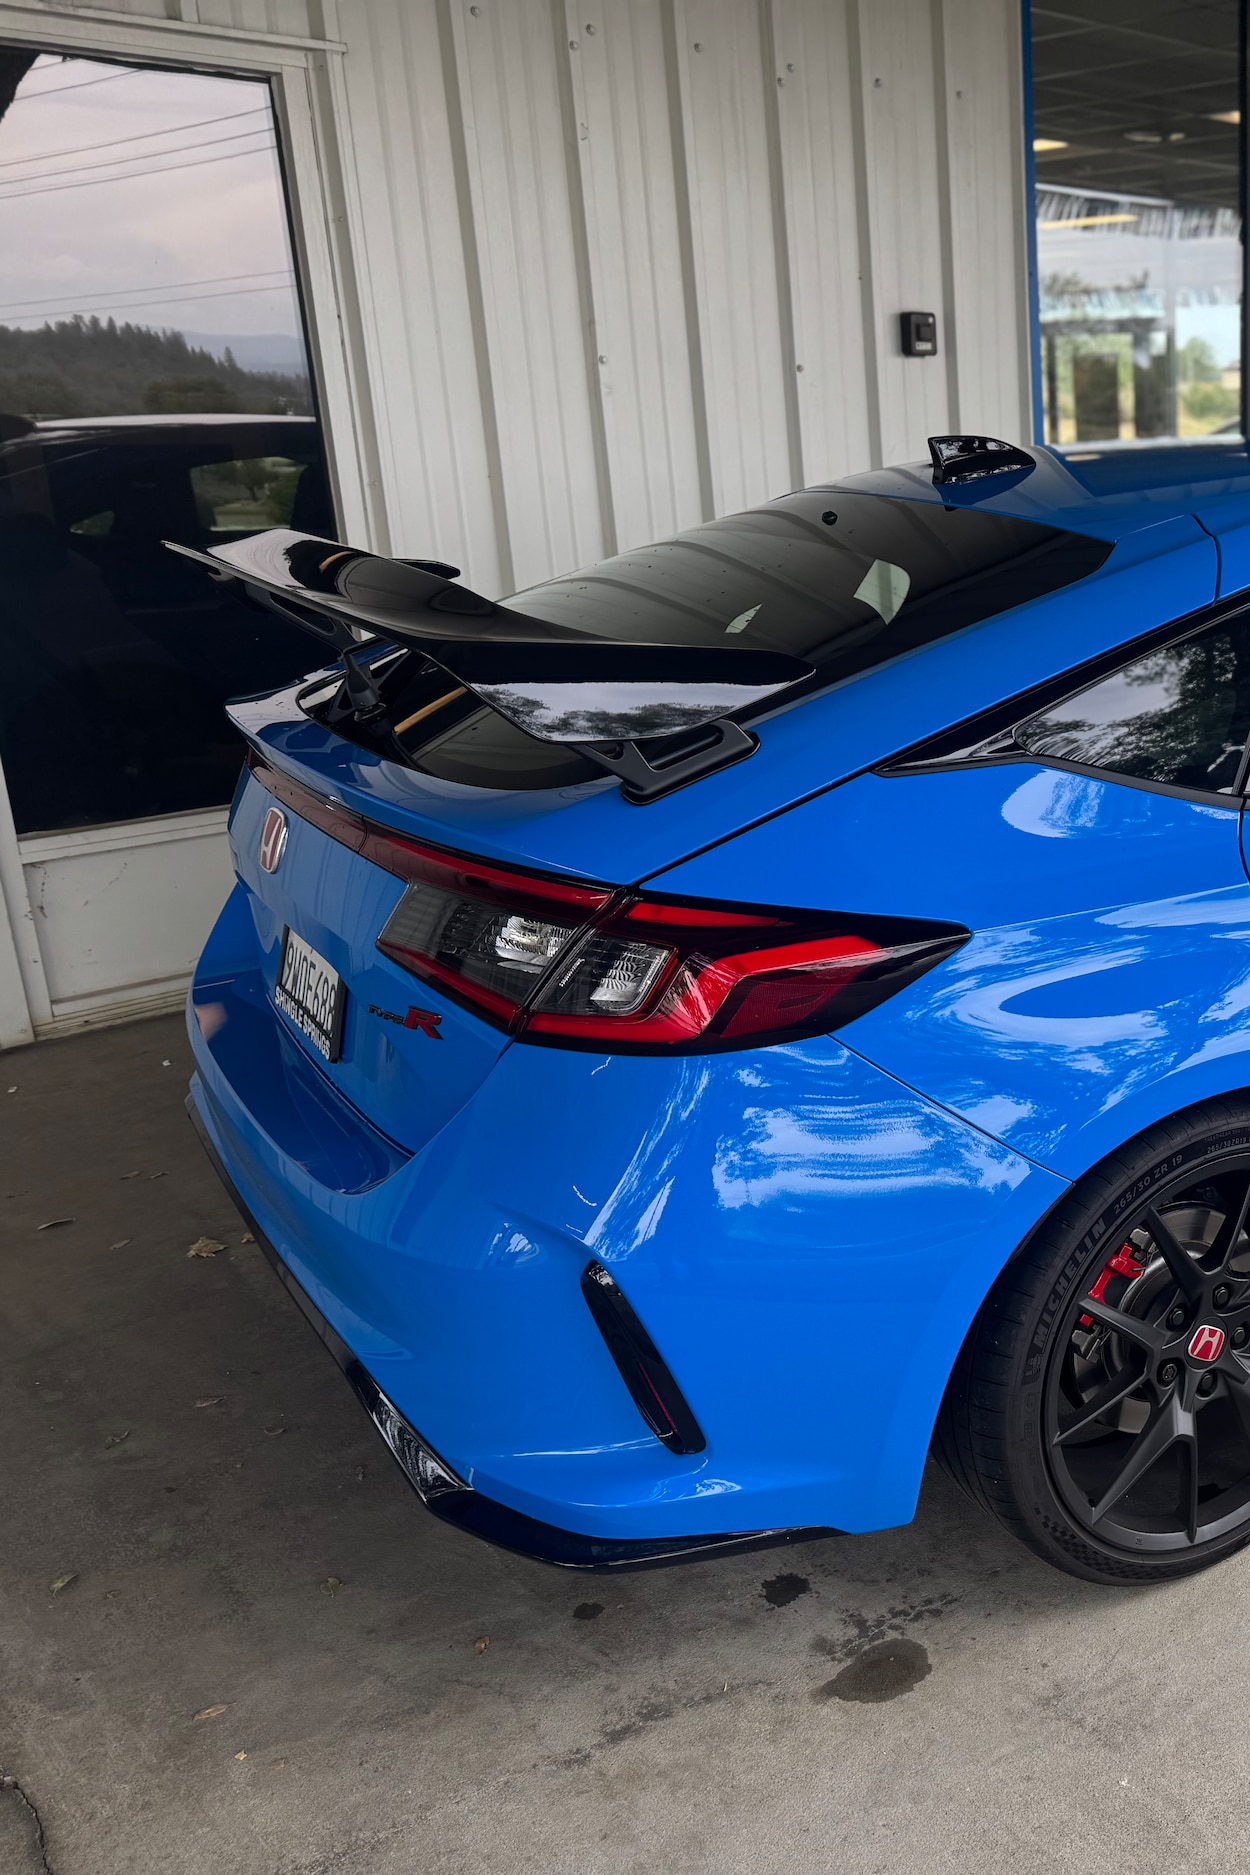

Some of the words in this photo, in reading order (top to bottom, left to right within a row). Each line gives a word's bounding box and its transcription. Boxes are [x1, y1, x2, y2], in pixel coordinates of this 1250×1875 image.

[275, 985, 303, 1029] SHINGLE
[302, 1014, 331, 1061] SPRINGS
[404, 1005, 444, 1040] R
[1033, 1217, 1107, 1349] MICHELIN
[1114, 1176, 1151, 1216] 265/30
[1154, 1162, 1169, 1179] ZR
[1172, 1154, 1183, 1166] 19
